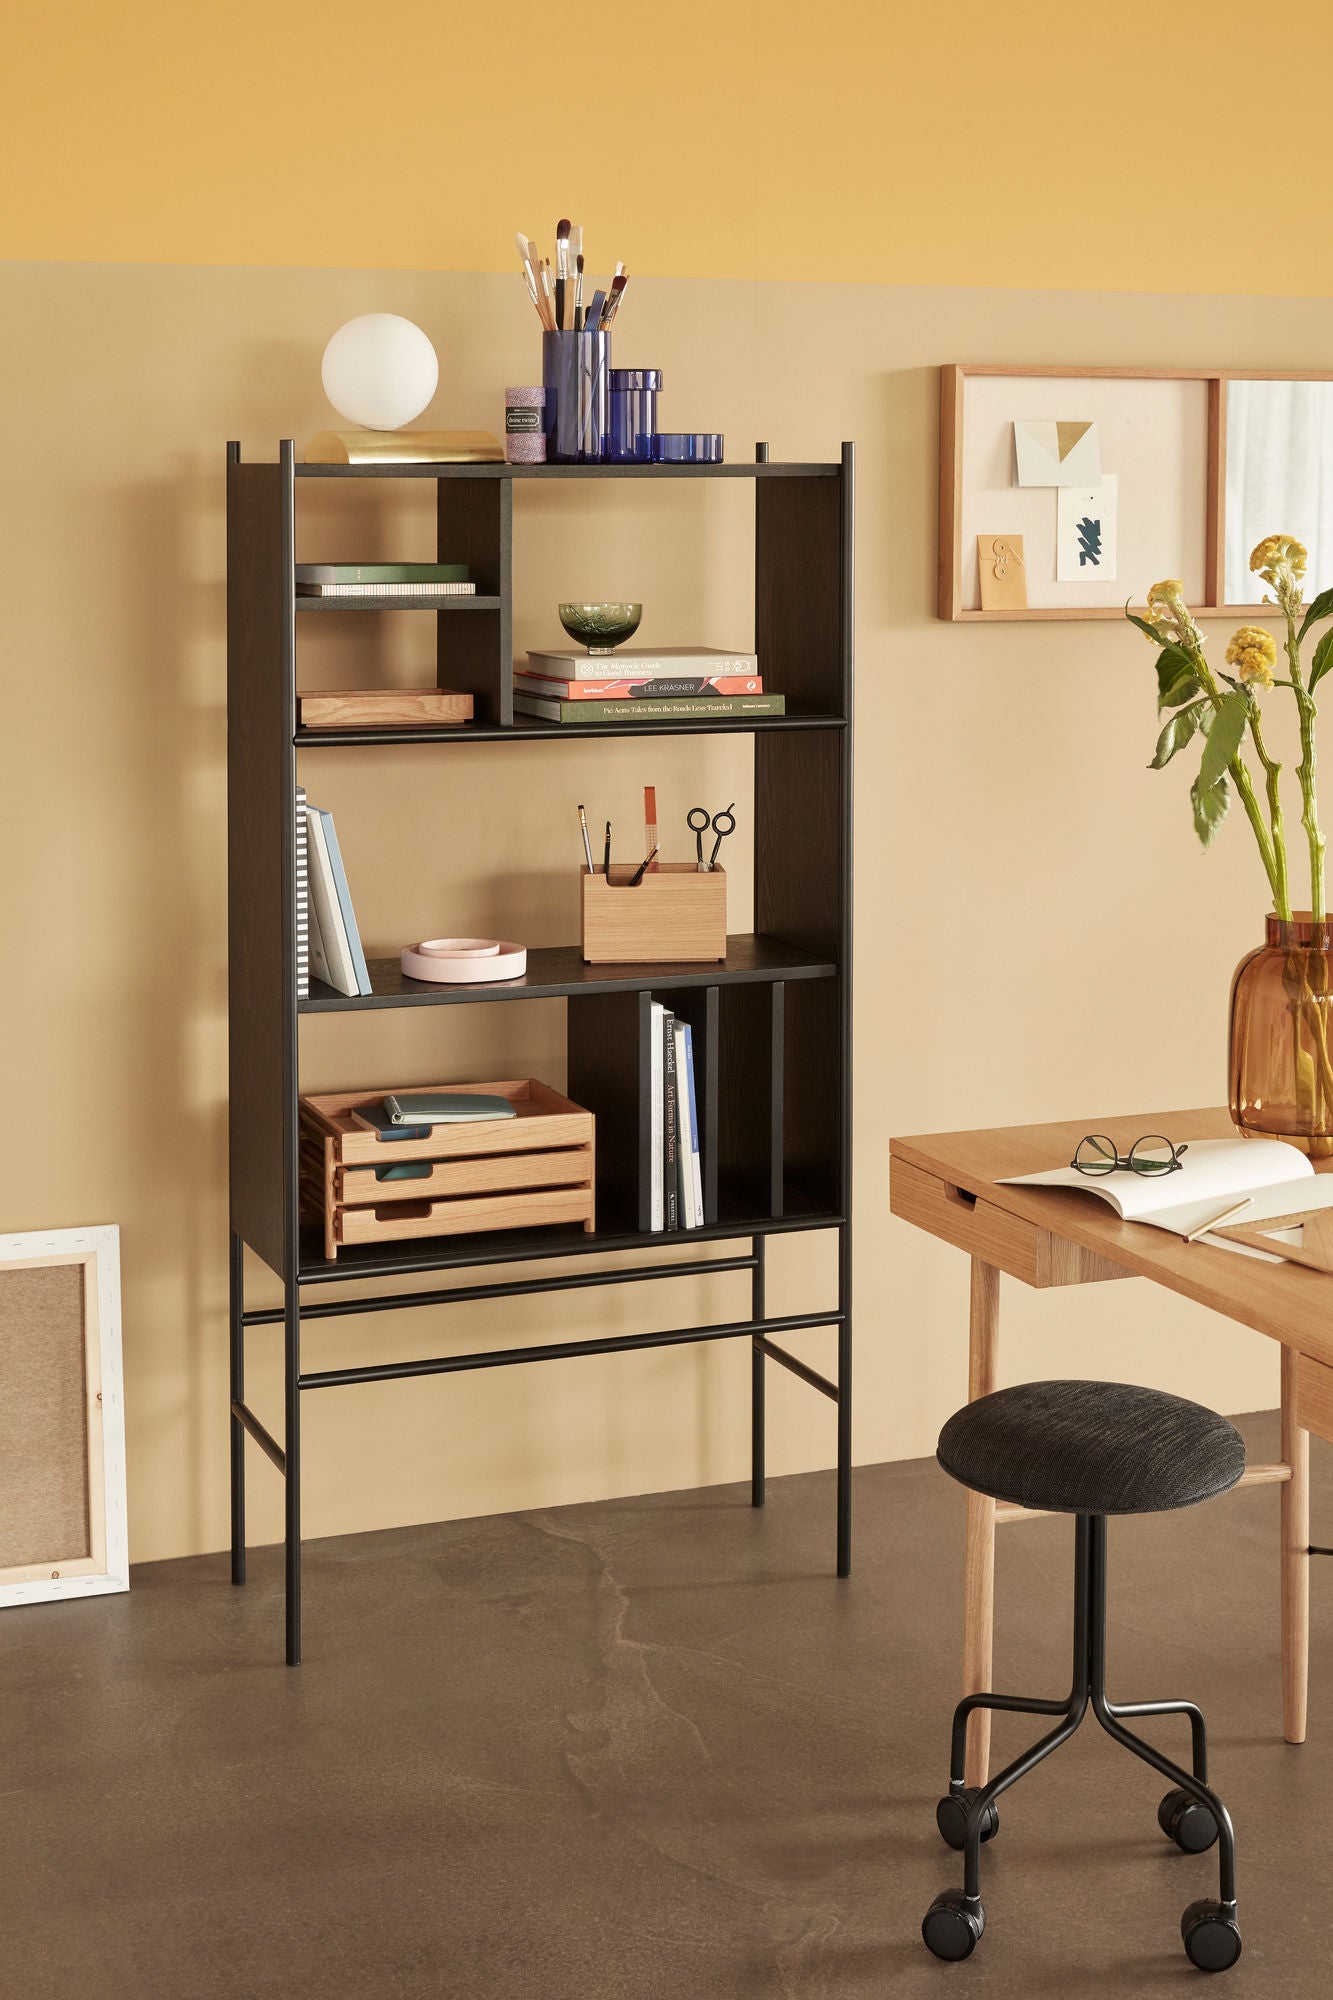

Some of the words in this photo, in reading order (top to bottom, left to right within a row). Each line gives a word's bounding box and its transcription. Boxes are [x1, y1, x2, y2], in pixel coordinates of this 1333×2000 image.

[610, 662, 639, 670] Monocle
[603, 669, 622, 677] Good
[644, 684, 658, 692] LEE
[660, 683, 695, 691] KRASNER
[707, 703, 733, 711] Traveled
[666, 1019, 674, 1041] Ernst
[667, 1041, 675, 1074] Haeckel
[667, 1084, 675, 1098] Art
[667, 1100, 676, 1124] Forms
[668, 1125, 675, 1134] in
[668, 1135, 676, 1163] Nature
